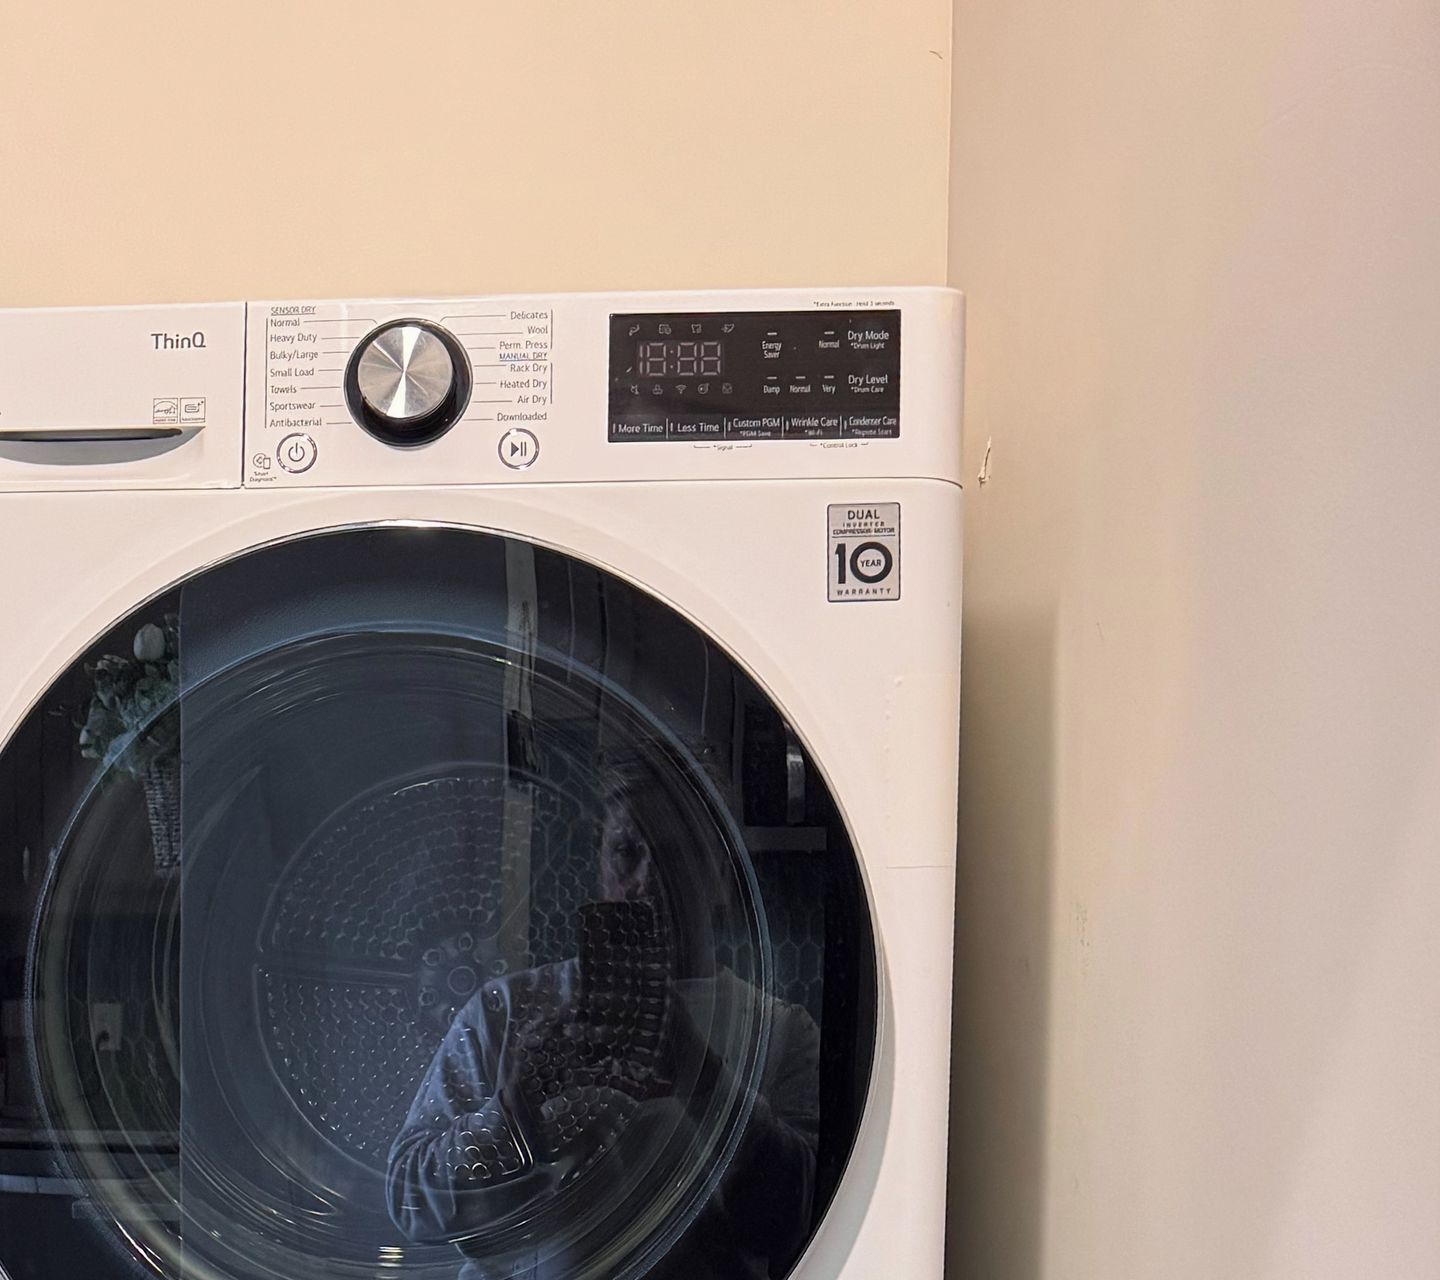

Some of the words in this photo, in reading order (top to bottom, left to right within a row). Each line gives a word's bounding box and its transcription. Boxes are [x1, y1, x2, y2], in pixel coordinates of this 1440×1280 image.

[271, 306, 300, 315] SENSOR
[301, 306, 317, 314] DRY
[510, 311, 548, 320] Delicates
[270, 318, 300, 327] Normal
[527, 326, 548, 335] Wool
[848, 330, 863, 342] Dry
[865, 330, 890, 341] Mode
[150, 331, 207, 350] ThinQ
[270, 333, 295, 344] Heavy
[297, 332, 318, 344] Duty
[525, 340, 548, 350] Press
[762, 340, 782, 351] Energy
[818, 340, 840, 349] Normal
[270, 349, 319, 361] Bulky/Large
[499, 352, 530, 360] MANUAL
[532, 351, 548, 360] DRY
[764, 351, 780, 359] Saver
[270, 368, 293, 378] Small
[294, 367, 315, 377] Load
[510, 363, 530, 373] Rack
[532, 362, 548, 374] Dry
[500, 379, 530, 389] Heated
[532, 379, 548, 390] Dry
[848, 374, 863, 386] Dry
[865, 374, 888, 384] Level
[271, 384, 297, 394] Towels
[763, 385, 781, 395] Damp
[789, 384, 811, 393] Normal
[822, 384, 836, 395] Very
[517, 395, 530, 404] Air
[532, 394, 547, 406] Dry
[270, 401, 316, 412] Sportswear
[269, 417, 323, 428] Antibacterial
[496, 412, 548, 422] Downloaded
[733, 418, 761, 428] Custom
[762, 417, 781, 428] PGM
[791, 417, 819, 427] Wrinkle
[820, 416, 839, 427] Care
[848, 416, 882, 426] Condenser
[882, 416, 897, 426] Care
[618, 423, 641, 433] More
[642, 423, 664, 433] Time
[677, 423, 697, 433] Less
[698, 422, 720, 432] Time
[847, 509, 881, 520] DUAL
[834, 541, 893, 585] 10
[860, 559, 882, 568] YEAR
[836, 587, 891, 596] WARRANTY
